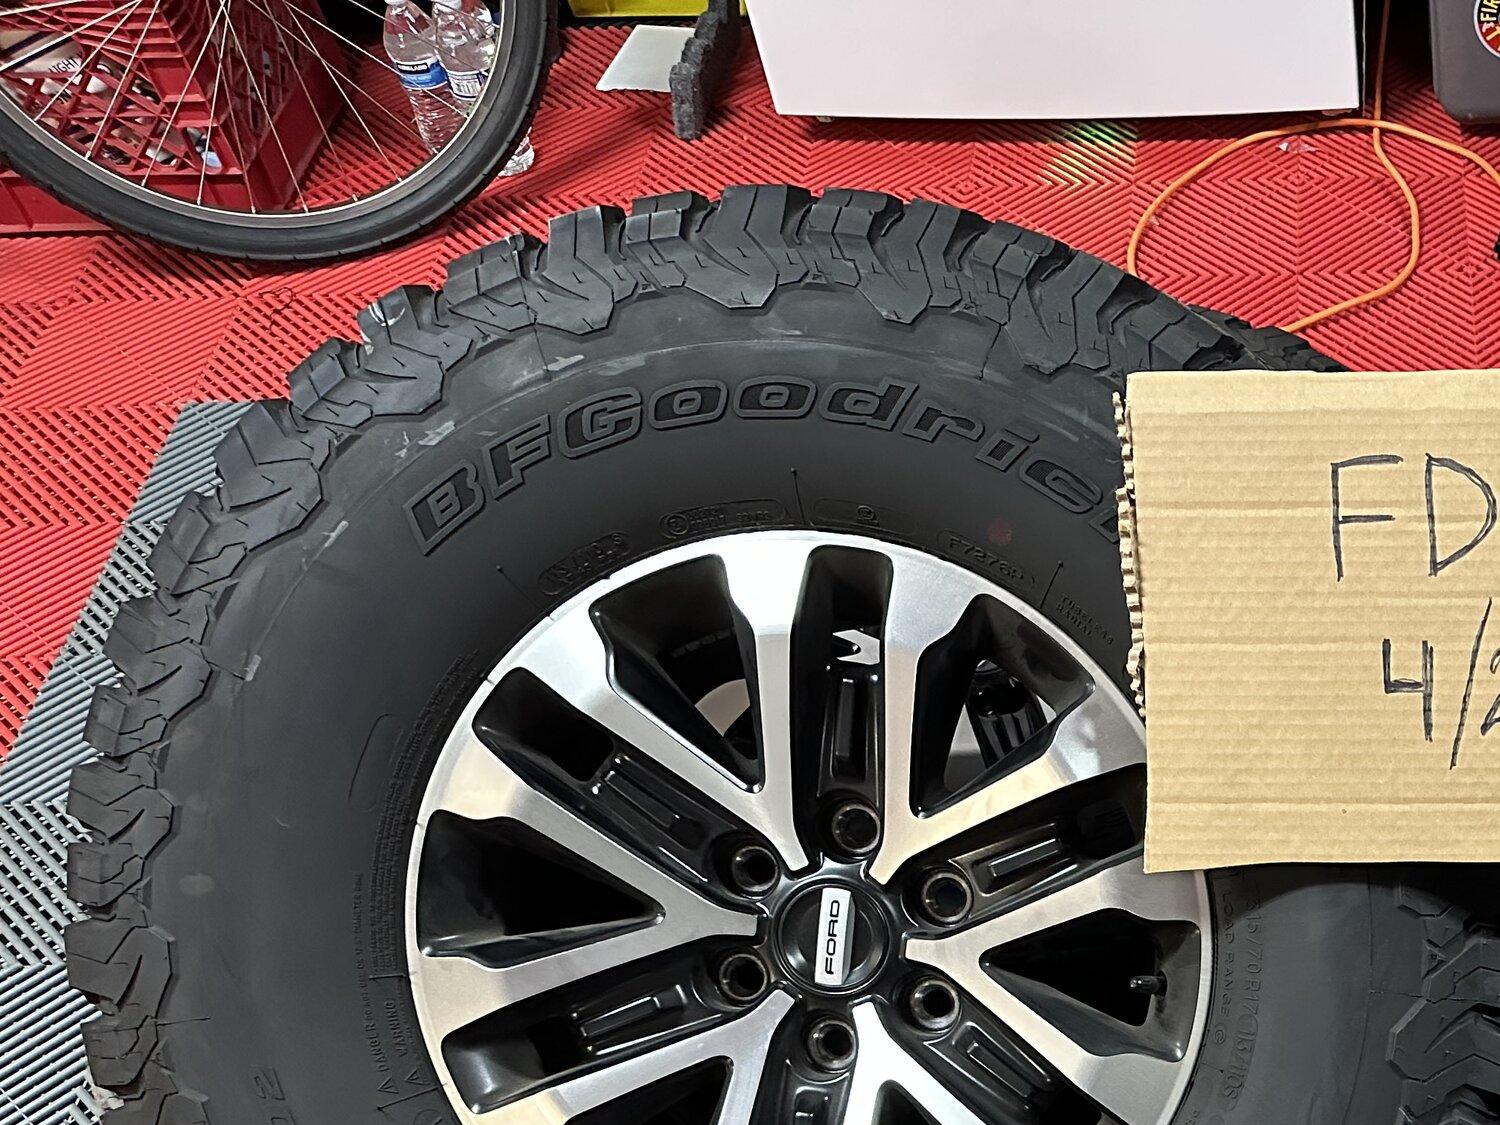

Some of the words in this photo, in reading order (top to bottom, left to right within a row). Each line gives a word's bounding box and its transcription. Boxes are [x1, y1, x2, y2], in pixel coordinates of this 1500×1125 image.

[825, 900, 840, 975] FORD
[1222, 890, 1234, 944] LOAD
[1216, 951, 1237, 1017] RANGE
[365, 1022, 390, 1073] DANGER
[384, 1000, 408, 1058] WARNING
